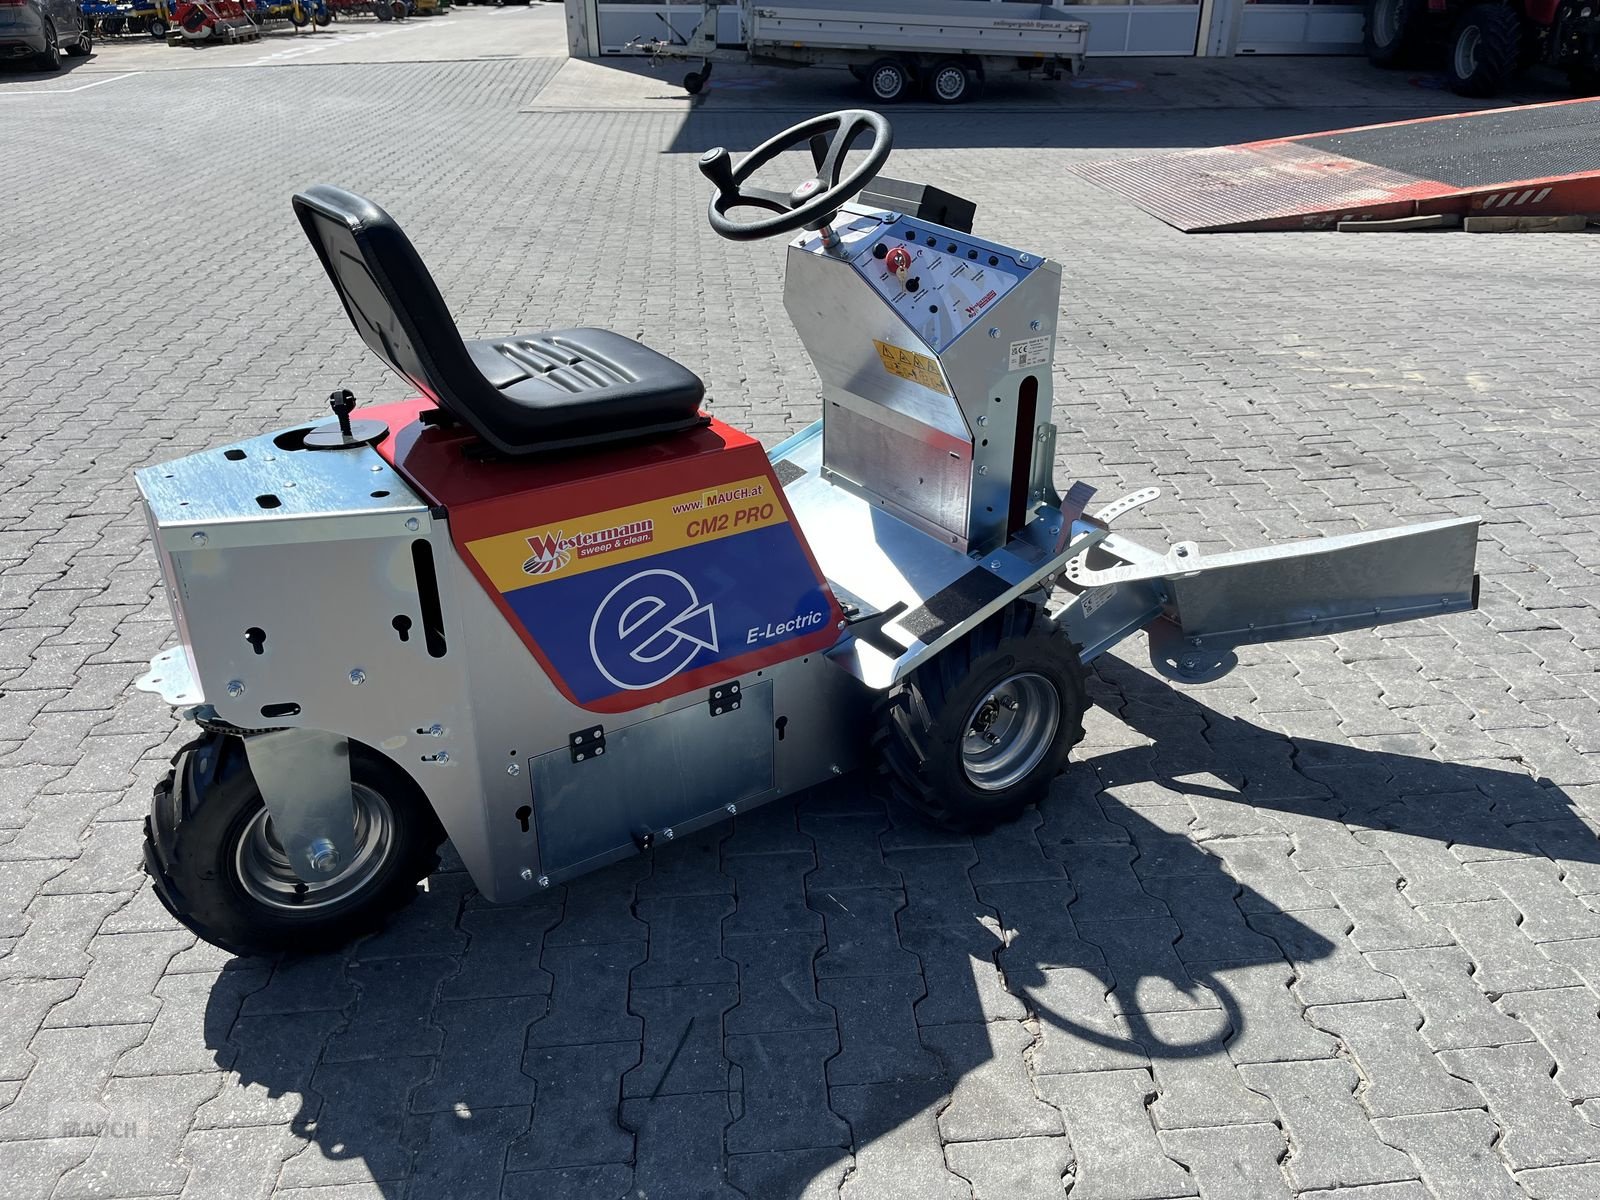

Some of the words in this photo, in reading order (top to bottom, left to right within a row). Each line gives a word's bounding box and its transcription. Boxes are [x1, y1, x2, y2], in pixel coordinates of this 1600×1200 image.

[686, 513, 729, 538] CM2
[733, 503, 774, 527] PRO
[525, 519, 653, 561] Westermann
[580, 543, 612, 556] sweep
[614, 539, 621, 547] &
[623, 533, 651, 546] clean.
[746, 611, 822, 644] E-Lectric
